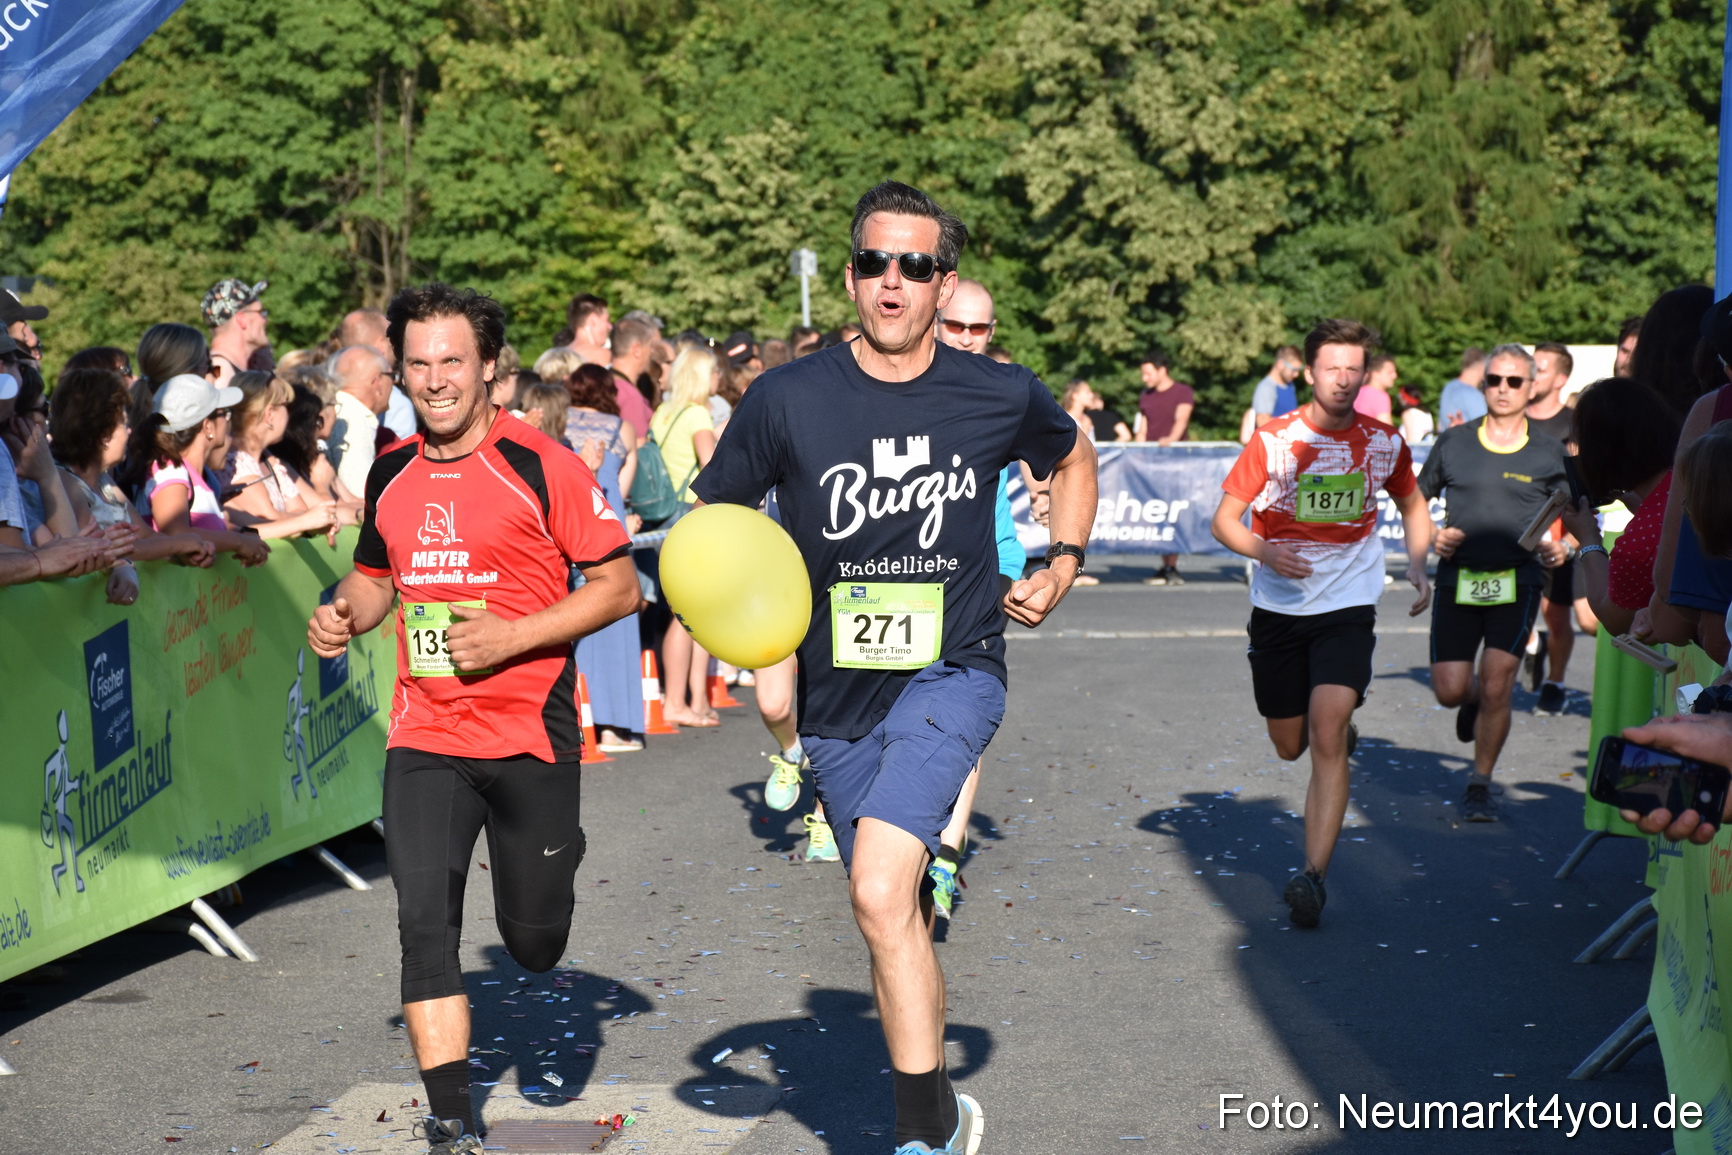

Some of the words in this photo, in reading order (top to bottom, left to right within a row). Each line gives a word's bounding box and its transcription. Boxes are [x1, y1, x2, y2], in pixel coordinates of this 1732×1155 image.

[819, 454, 977, 549] Burgis
[1307, 490, 1354, 509] 1871
[411, 551, 470, 568] MEYER
[466, 572, 498, 584] GmbH
[1470, 580, 1502, 595] 283
[844, 596, 881, 604] firmenlauf
[853, 614, 912, 644] 271
[413, 656, 440, 664] Schmeller
[859, 646, 887, 655] Burger
[97, 667, 124, 700] Fischer
[308, 649, 380, 758] firmenlauf
[77, 708, 172, 848] firmenlauf
[315, 745, 350, 788] neumarkt
[86, 825, 131, 881] neumarkt
